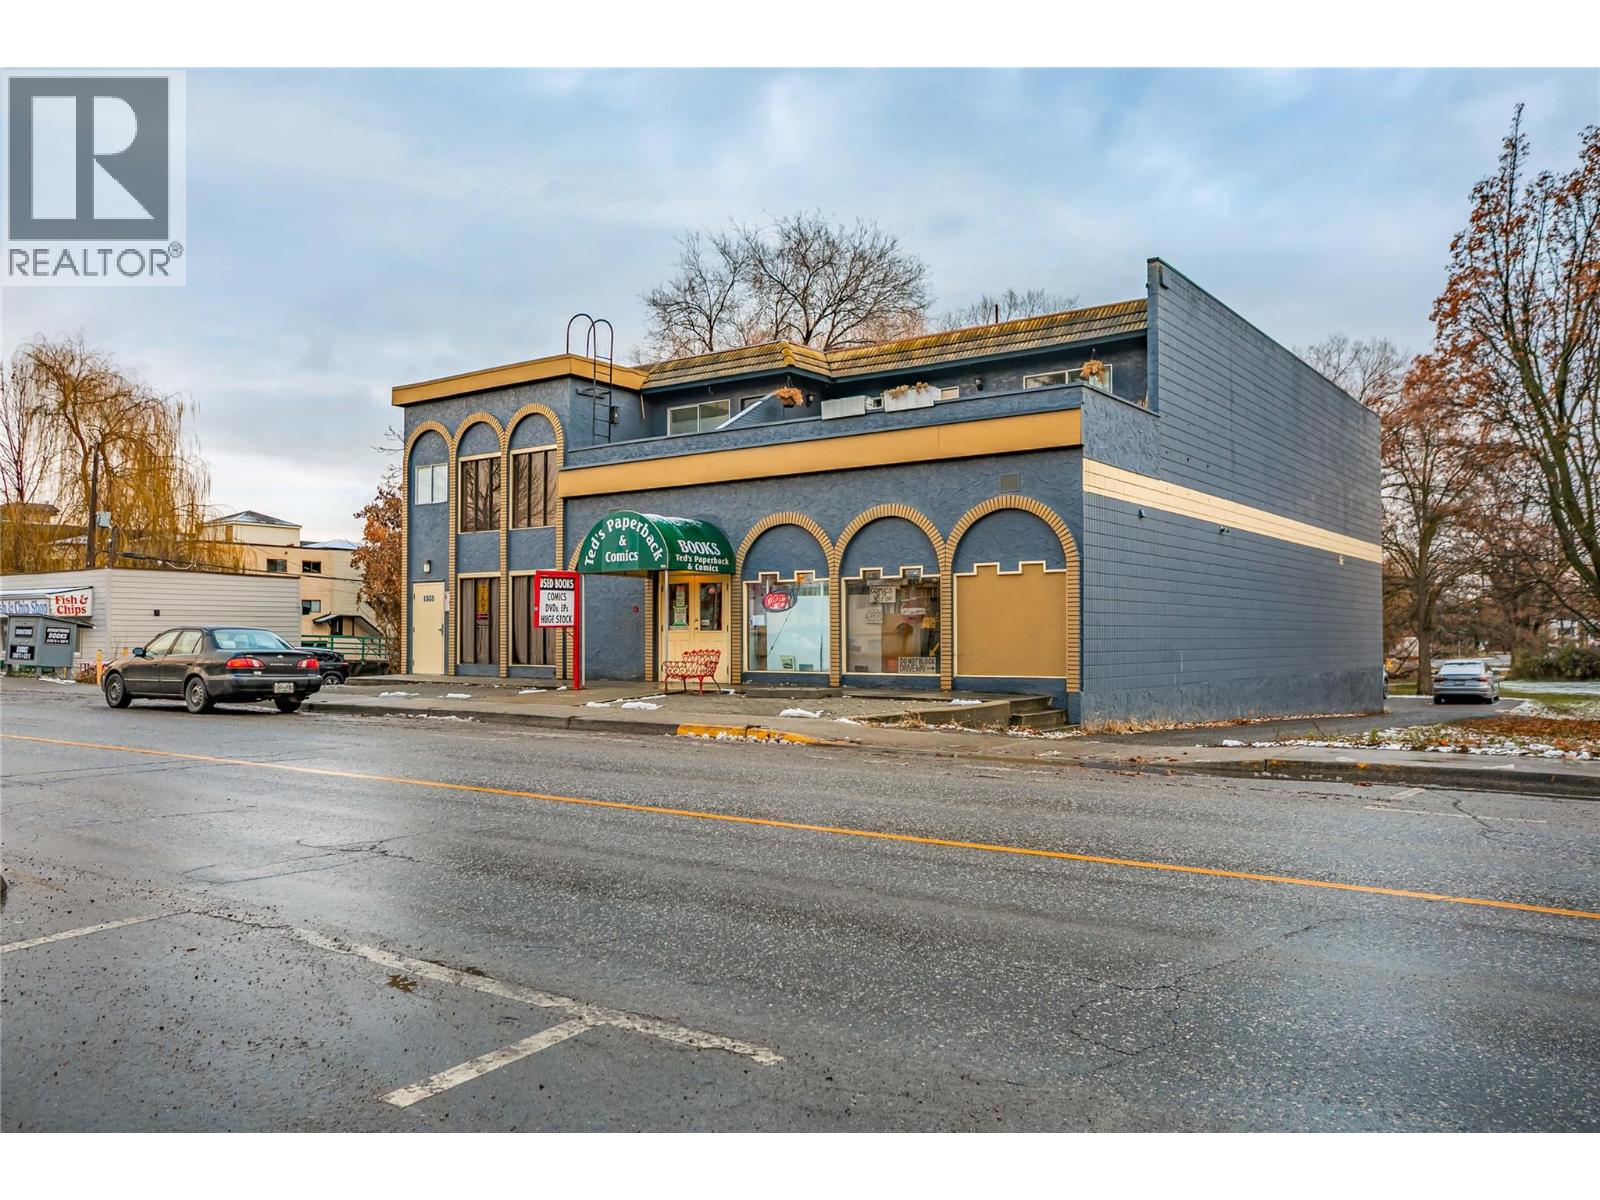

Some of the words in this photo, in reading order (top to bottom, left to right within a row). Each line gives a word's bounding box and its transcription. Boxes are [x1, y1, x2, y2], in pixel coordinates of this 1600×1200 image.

[584, 529, 606, 566] Ted's
[606, 517, 664, 562] Paperback
[618, 534, 628, 547] &
[677, 539, 721, 556] BOOKS
[605, 549, 639, 563] Comics
[676, 554, 693, 563] Ted's
[694, 555, 730, 566] Paperback
[687, 562, 693, 570] &
[694, 563, 719, 572] Comics
[540, 577, 554, 589] USED
[554, 577, 575, 589] BOOKS
[55, 594, 78, 605] Fish
[79, 594, 89, 605] &
[547, 592, 567, 601] COMICS
[56, 604, 87, 616] Chips
[540, 615, 555, 624] HUGE
[555, 615, 573, 624] STOCK
